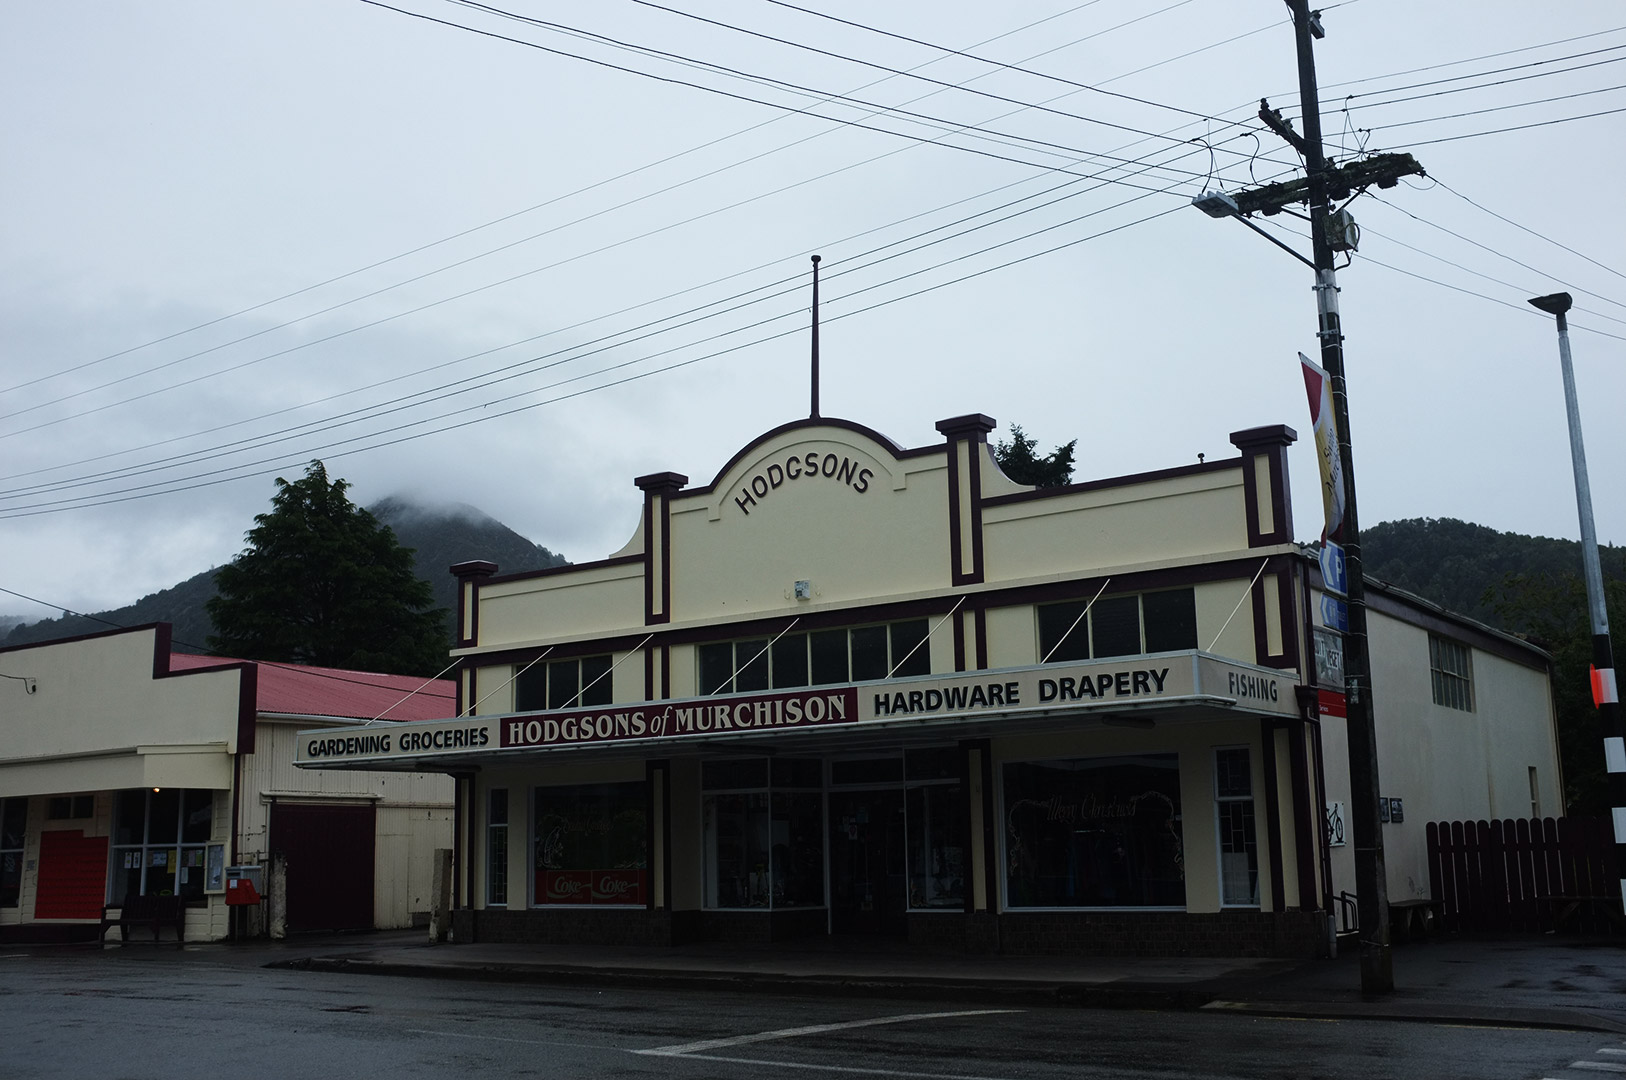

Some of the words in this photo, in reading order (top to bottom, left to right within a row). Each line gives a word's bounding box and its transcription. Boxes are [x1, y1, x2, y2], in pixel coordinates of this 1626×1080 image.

[735, 452, 874, 515] HODGSONS
[1335, 555, 1343, 582] P
[874, 682, 1020, 716] HARDWARE
[1038, 668, 1170, 703] DRAPERY
[1228, 671, 1278, 702] FISHING
[509, 712, 647, 745] HODGSONS
[650, 706, 673, 737] of
[675, 694, 846, 732] MURCHISON
[307, 735, 391, 757] GARDENING
[399, 727, 489, 750] GROCERIES
[1047, 793, 1077, 822] Merry
[1081, 792, 1137, 819] Christmas
[554, 875, 582, 893] Coke
[600, 875, 628, 893] Coke
